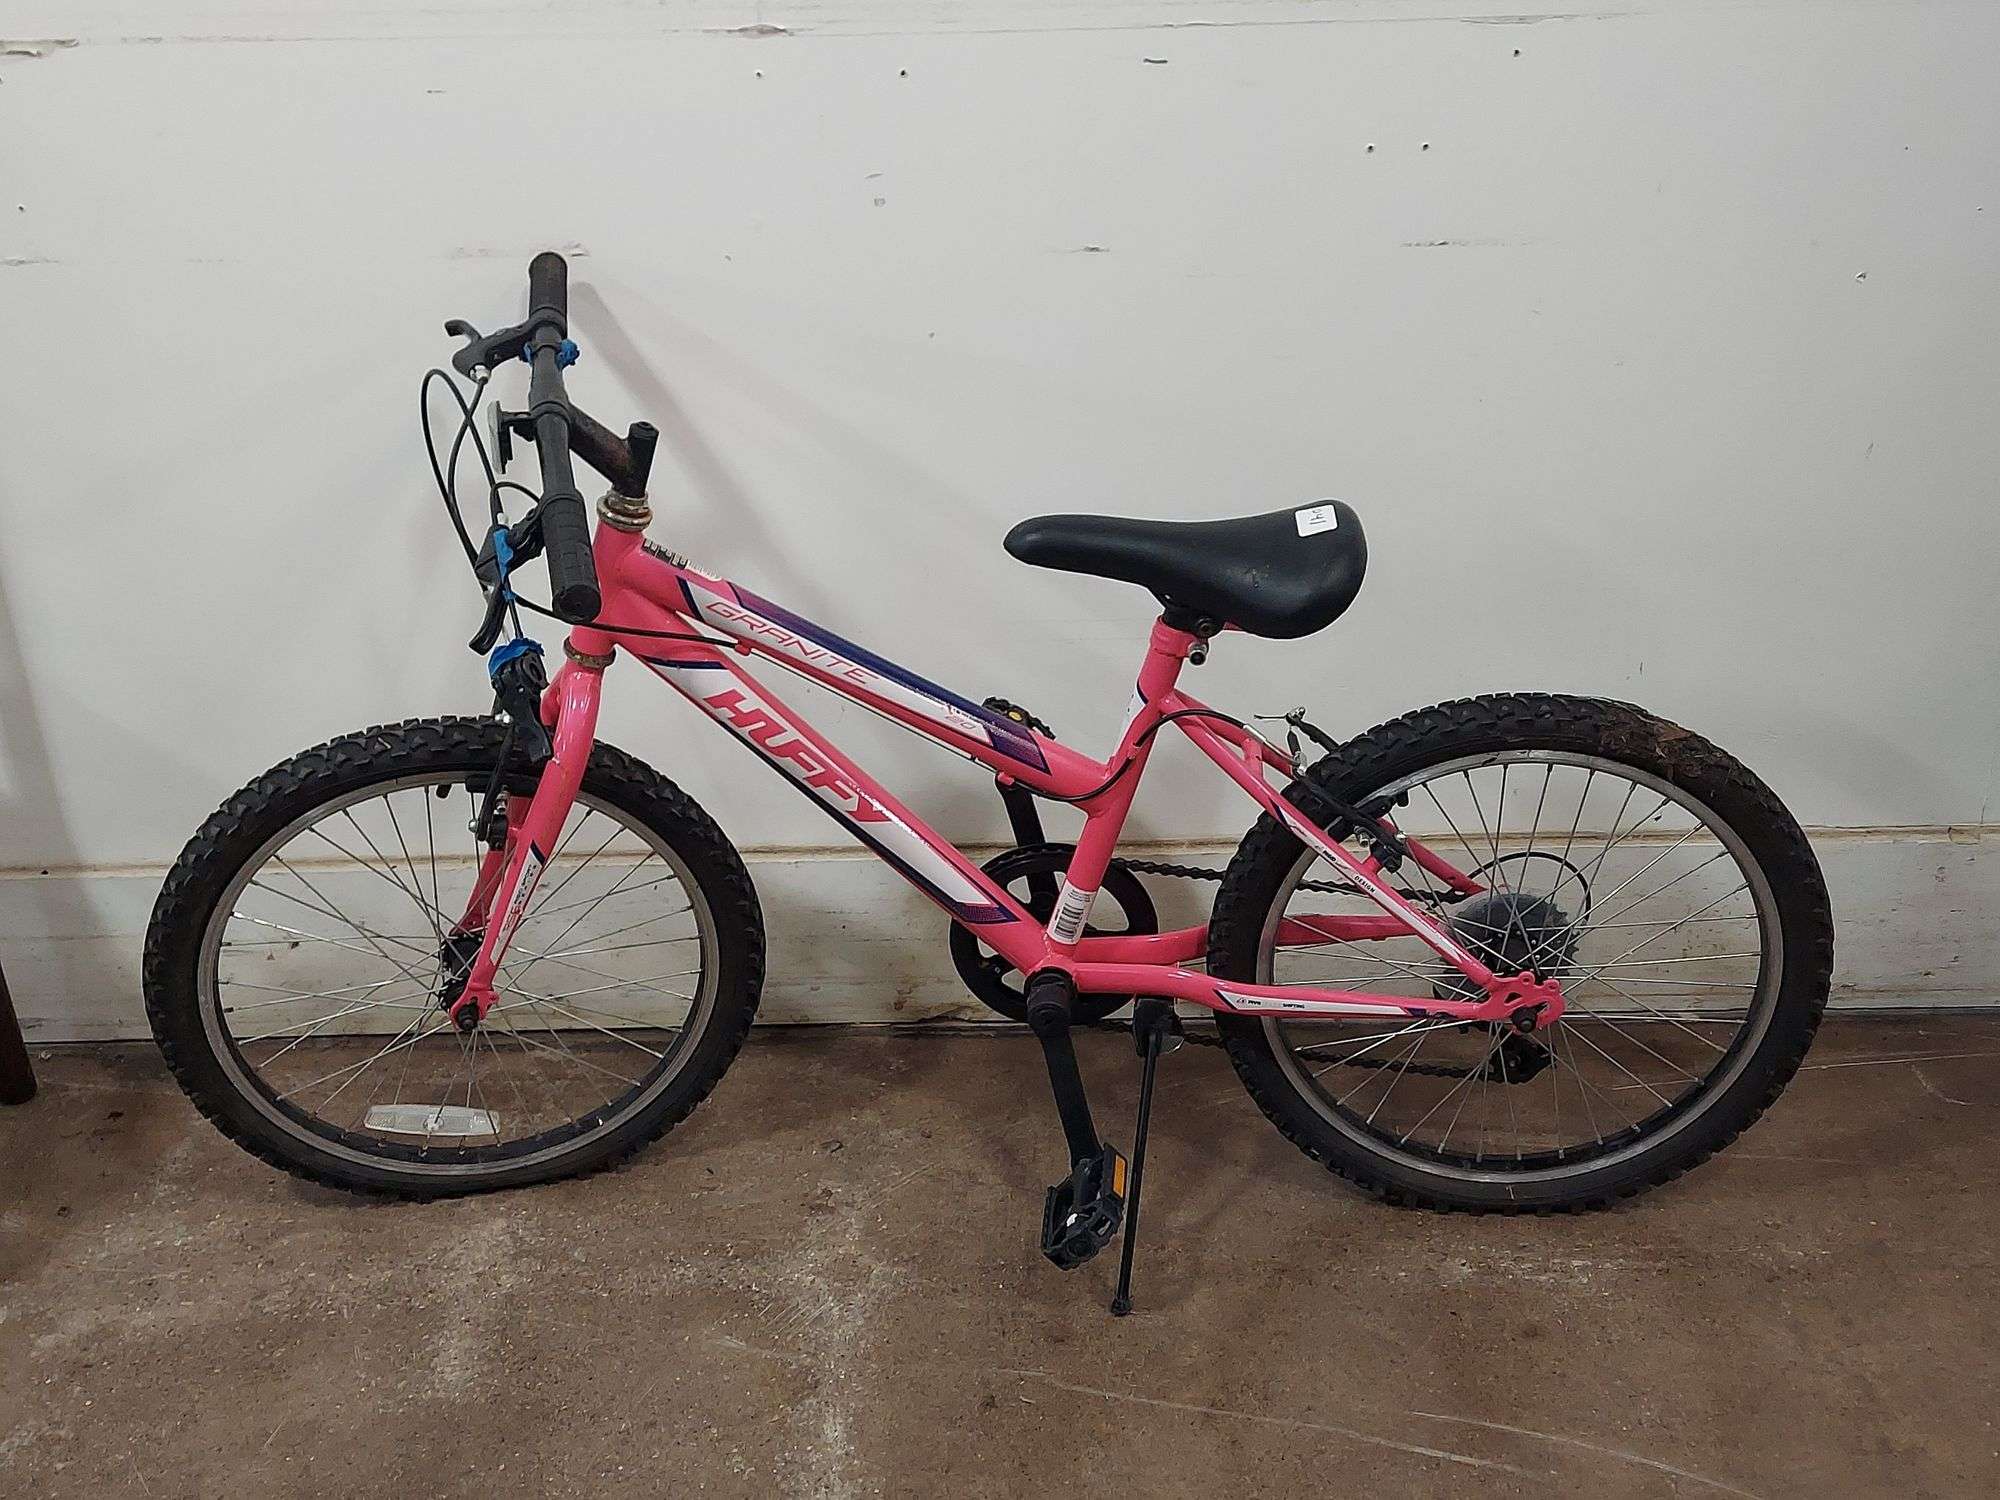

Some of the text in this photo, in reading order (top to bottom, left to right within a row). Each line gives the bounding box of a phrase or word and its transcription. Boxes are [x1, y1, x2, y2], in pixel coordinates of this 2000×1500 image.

[706, 601, 880, 685] GRANITE
[702, 688, 893, 822] HUFFY
[1353, 875, 1376, 894] DESIGN
